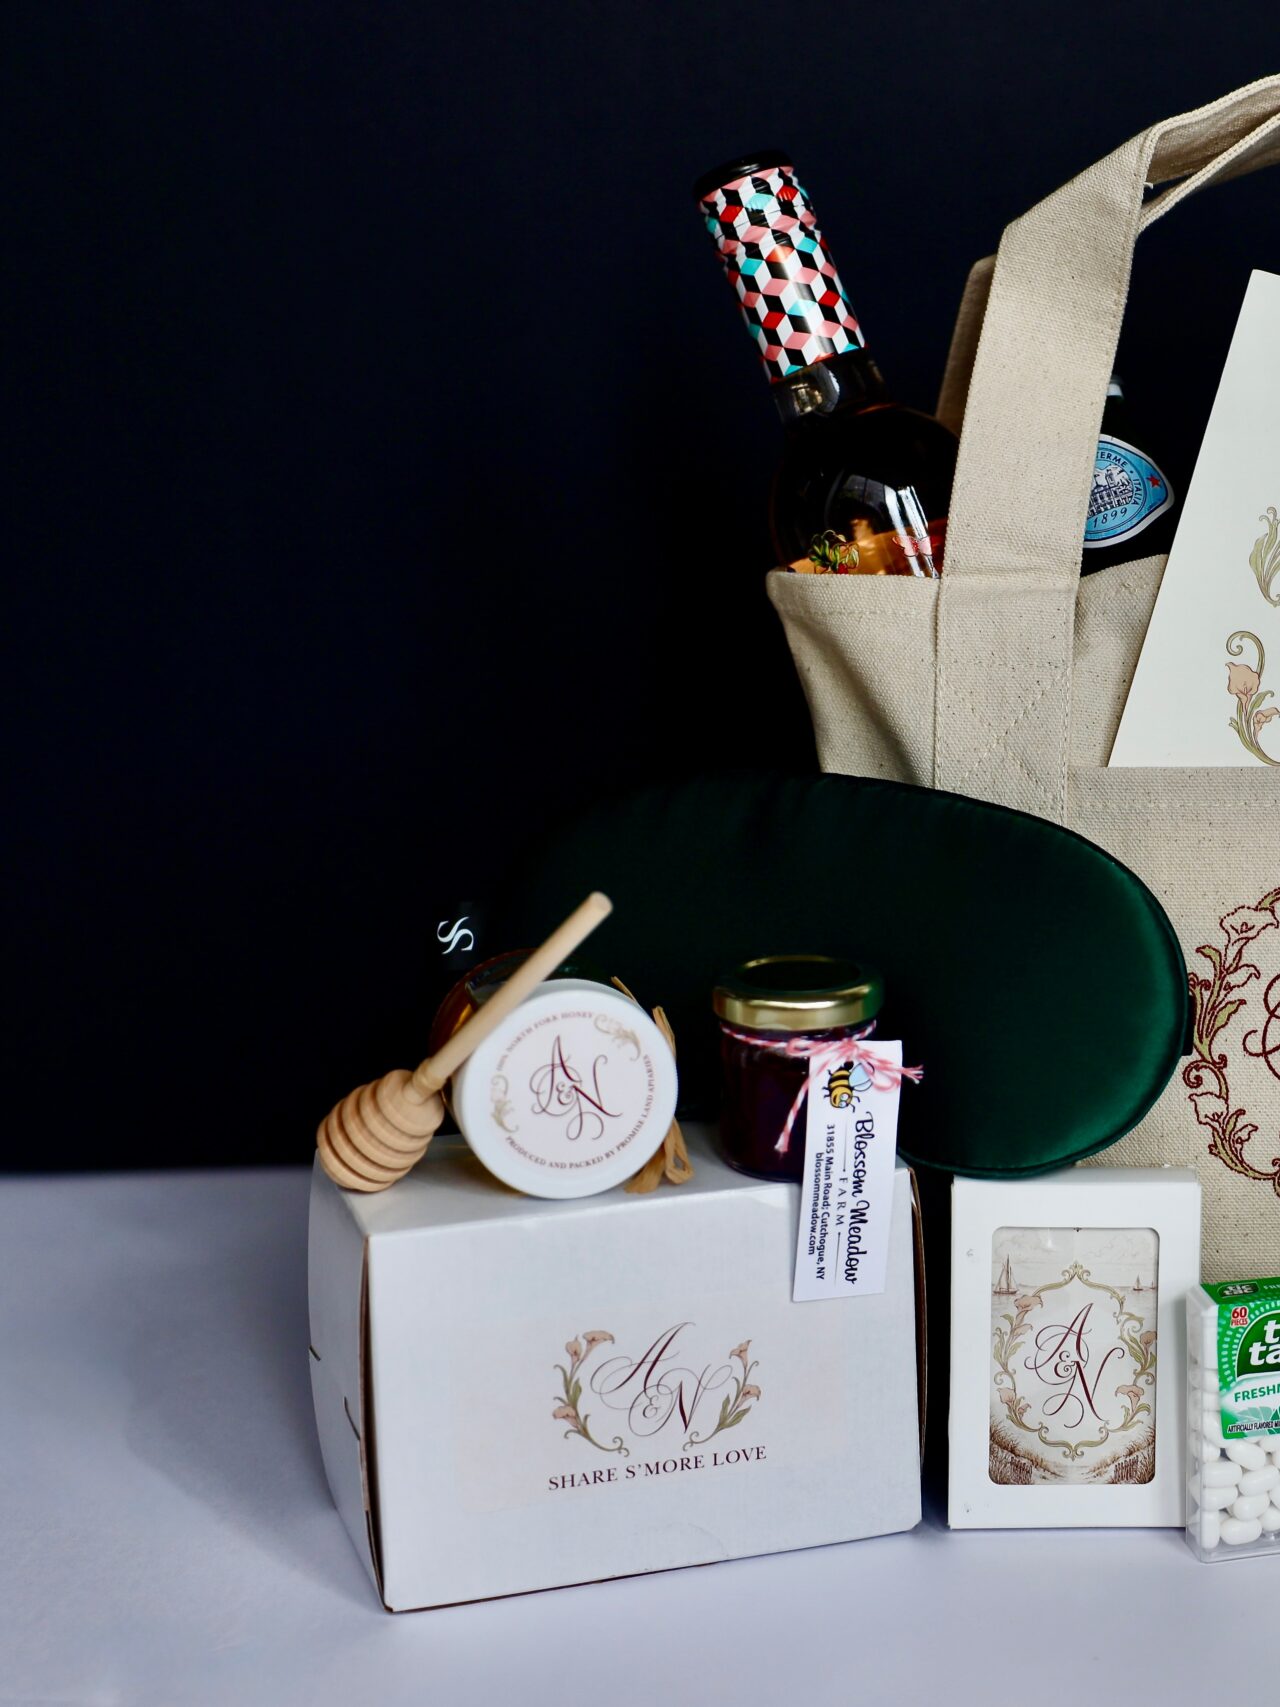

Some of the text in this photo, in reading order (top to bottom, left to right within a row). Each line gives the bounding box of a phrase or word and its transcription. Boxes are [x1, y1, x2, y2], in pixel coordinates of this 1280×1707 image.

[1131, 478, 1142, 505] ITALIA
[1093, 507, 1127, 528] 1899
[505, 1135, 546, 1166] PRODUCED
[548, 1161, 567, 1169] AND
[569, 1157, 604, 1169] PACKED
[604, 1147, 616, 1159] BY
[615, 1120, 645, 1152] PROMISE
[642, 1095, 654, 1118] LAND
[827, 1124, 836, 1155] 31855
[824, 1155, 834, 1182] Main
[808, 1152, 823, 1256] blossommeadow.com
[835, 1176, 849, 1227] FARM
[844, 1111, 875, 1285] Blossom Meadow
[816, 1268, 826, 1281] NY
[1231, 1307, 1247, 1319] 60
[548, 1467, 618, 1491] SHARE
[712, 1446, 767, 1467] LOVE
